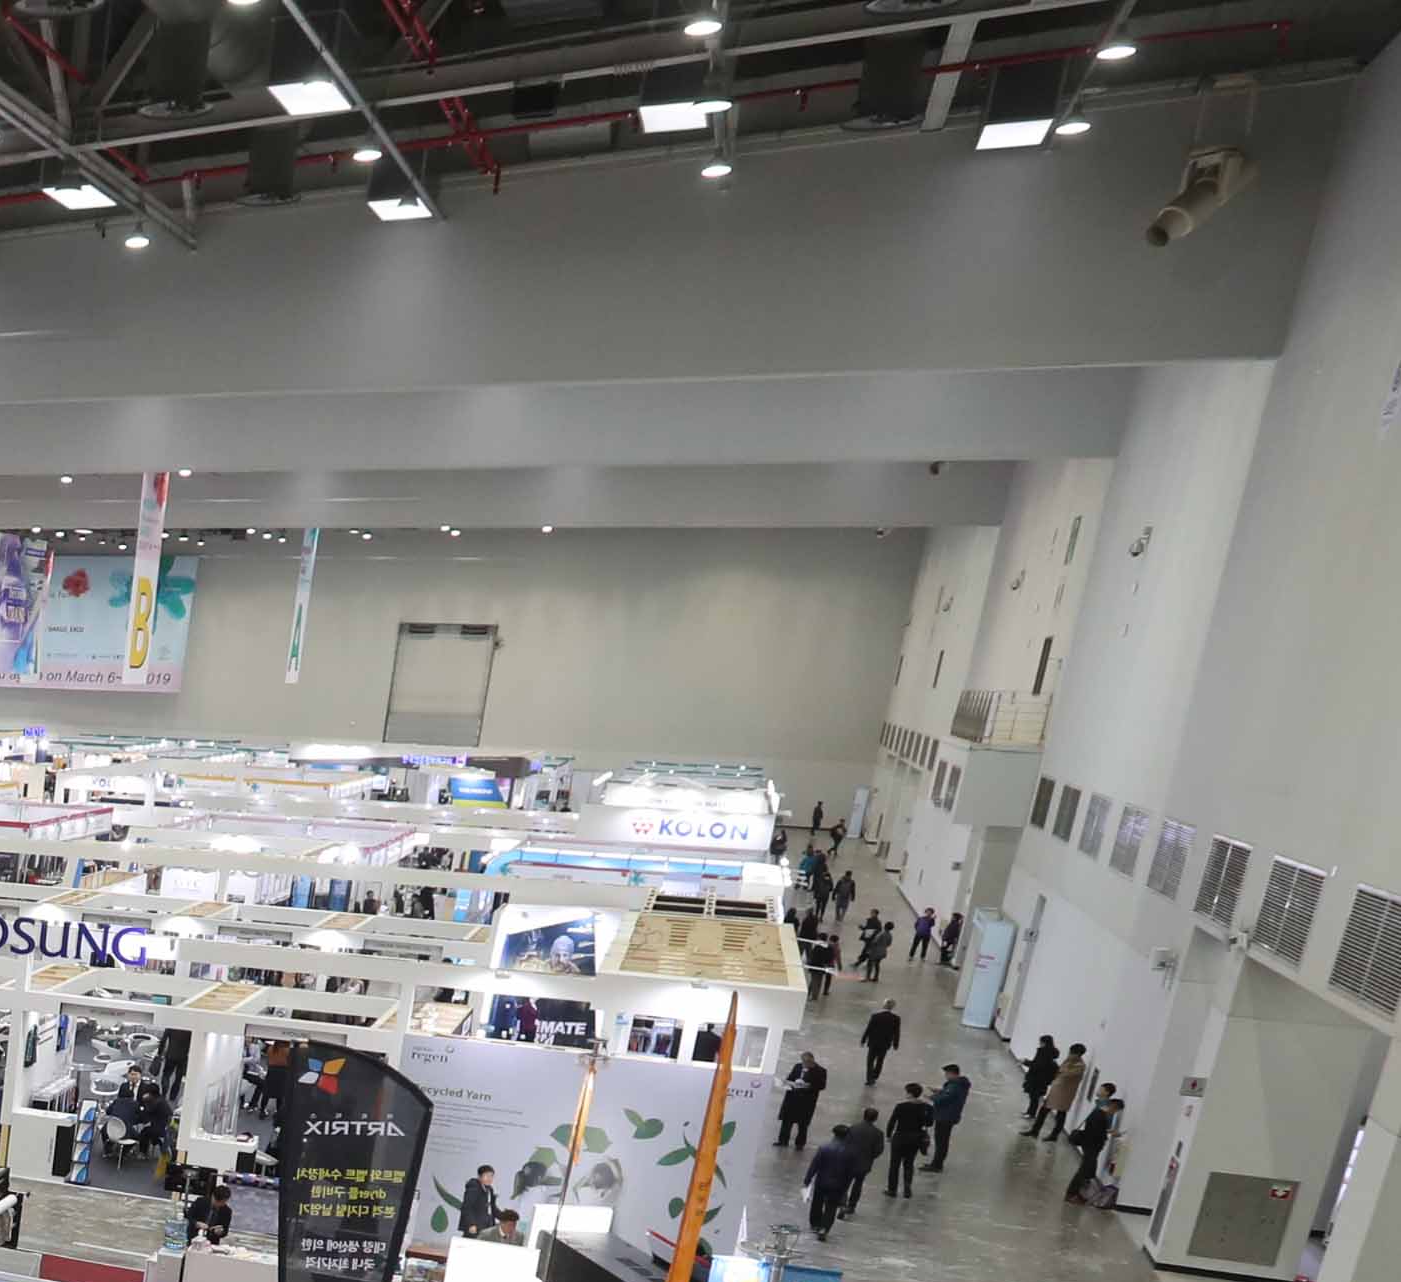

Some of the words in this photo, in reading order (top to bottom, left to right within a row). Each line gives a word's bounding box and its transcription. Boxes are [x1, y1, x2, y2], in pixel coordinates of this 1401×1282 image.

[129, 576, 153, 669] B
[66, 669, 103, 683] March
[657, 818, 750, 842] KOLON
[410, 1051, 449, 1064] regen
[419, 1085, 463, 1098] ecycled
[466, 1090, 492, 1102] Yarn
